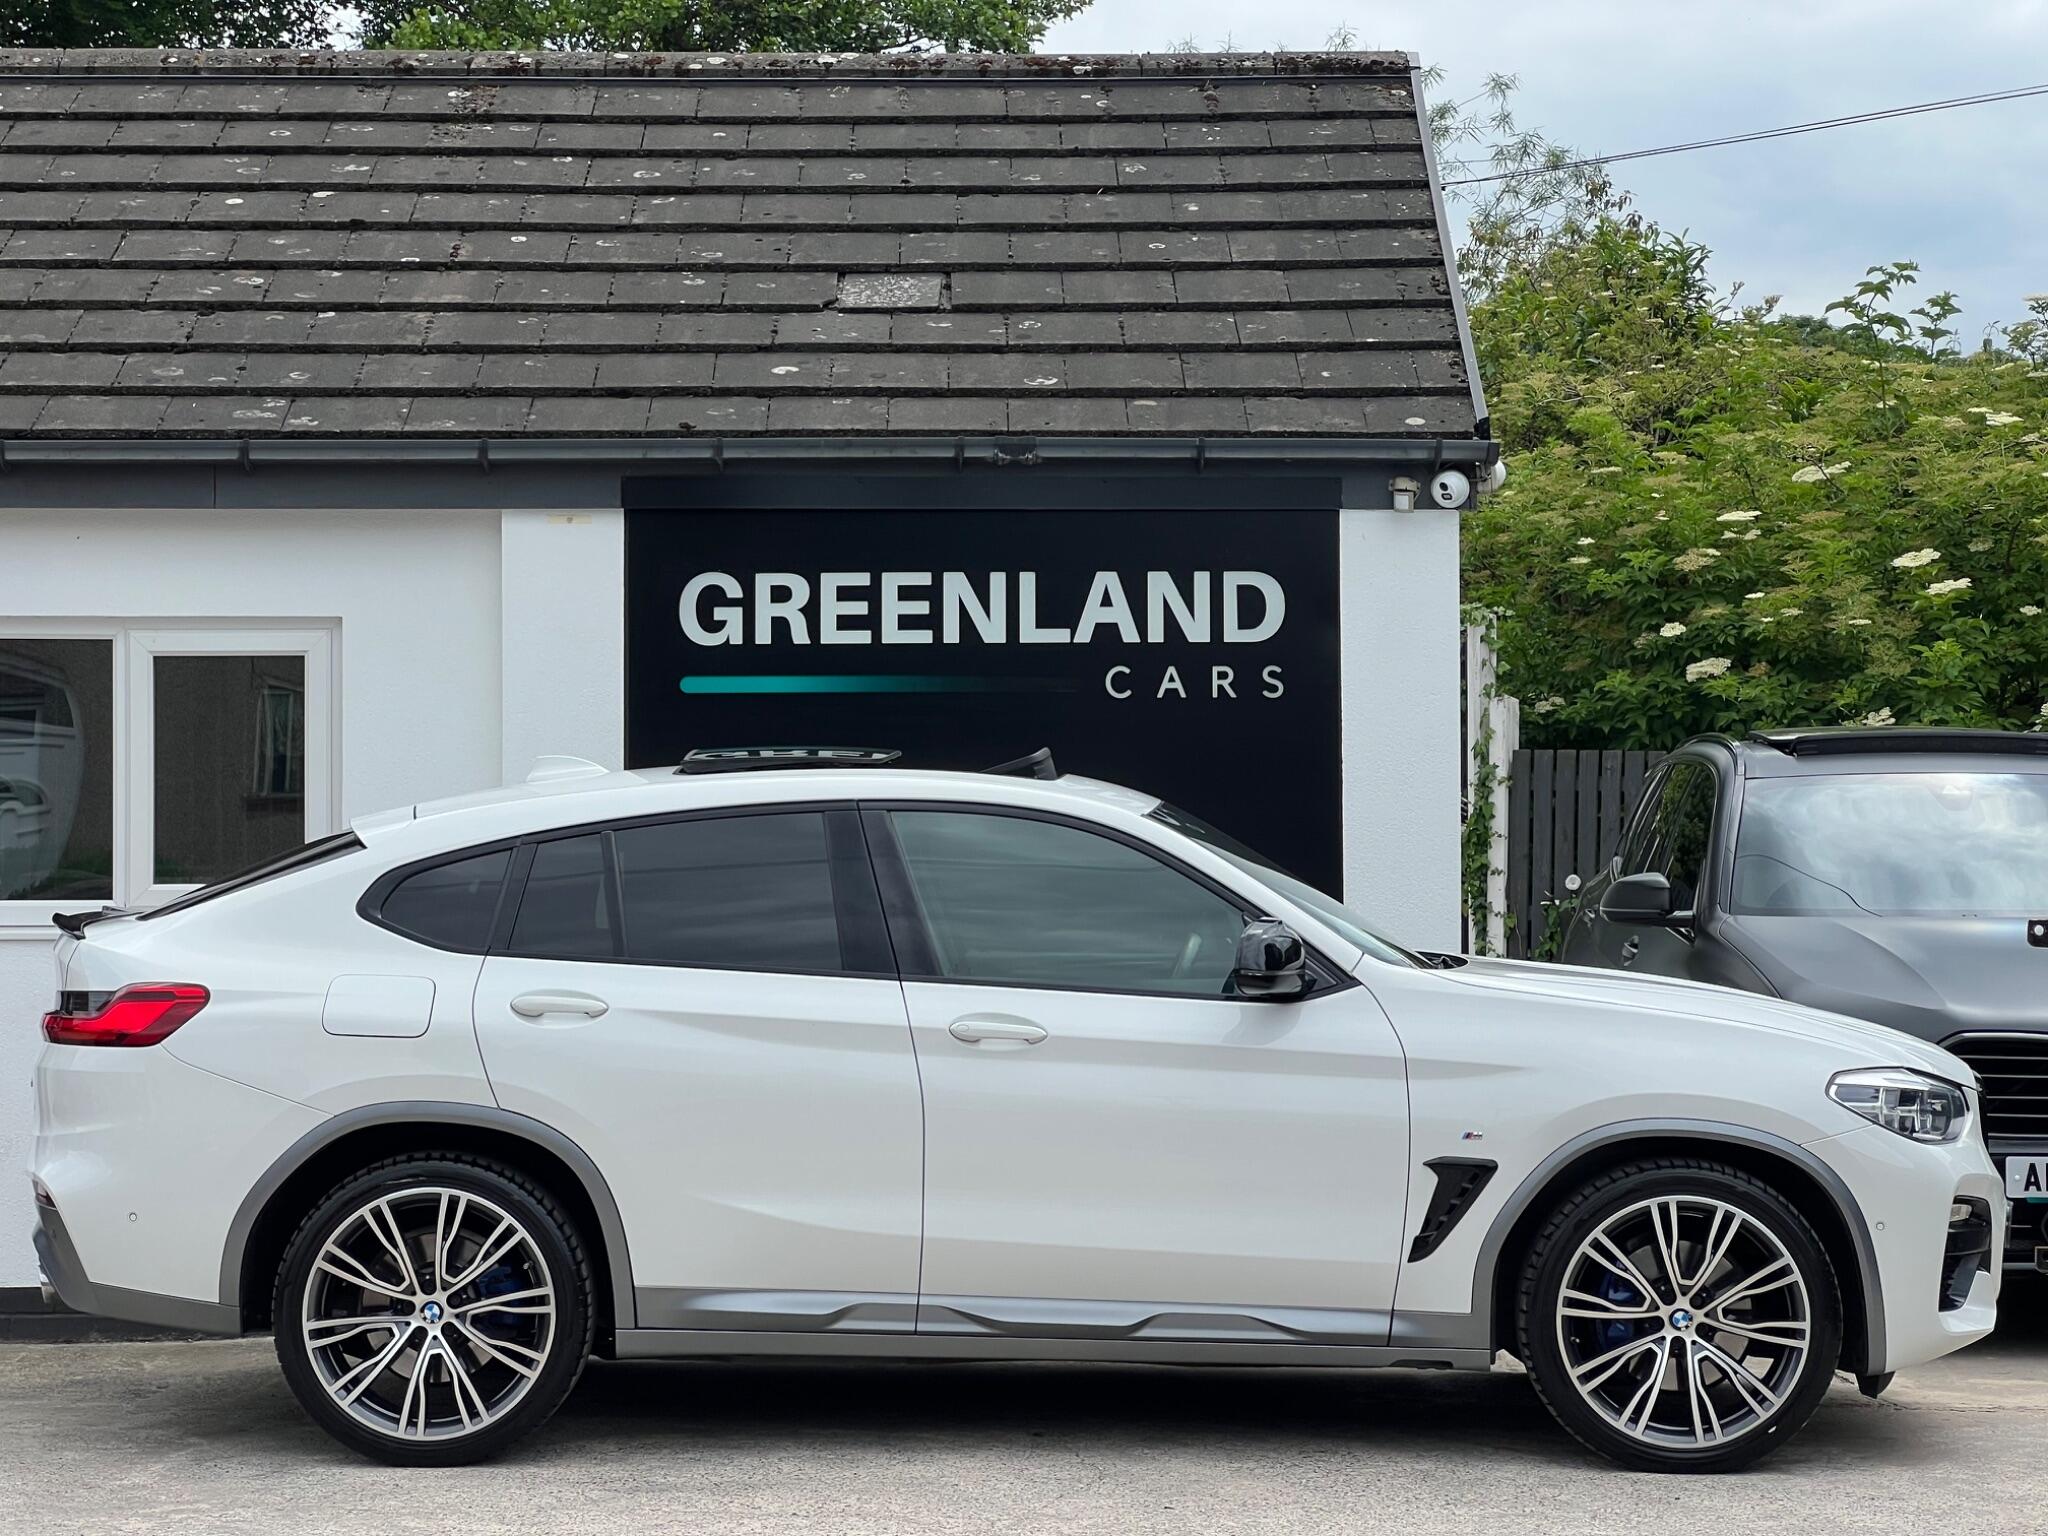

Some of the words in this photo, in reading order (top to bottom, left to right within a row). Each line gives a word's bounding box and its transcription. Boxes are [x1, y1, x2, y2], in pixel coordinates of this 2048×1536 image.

[678, 570, 1286, 647] GREENLAND
[1105, 665, 1284, 699] CARS
[2023, 1162, 2048, 1192] A
